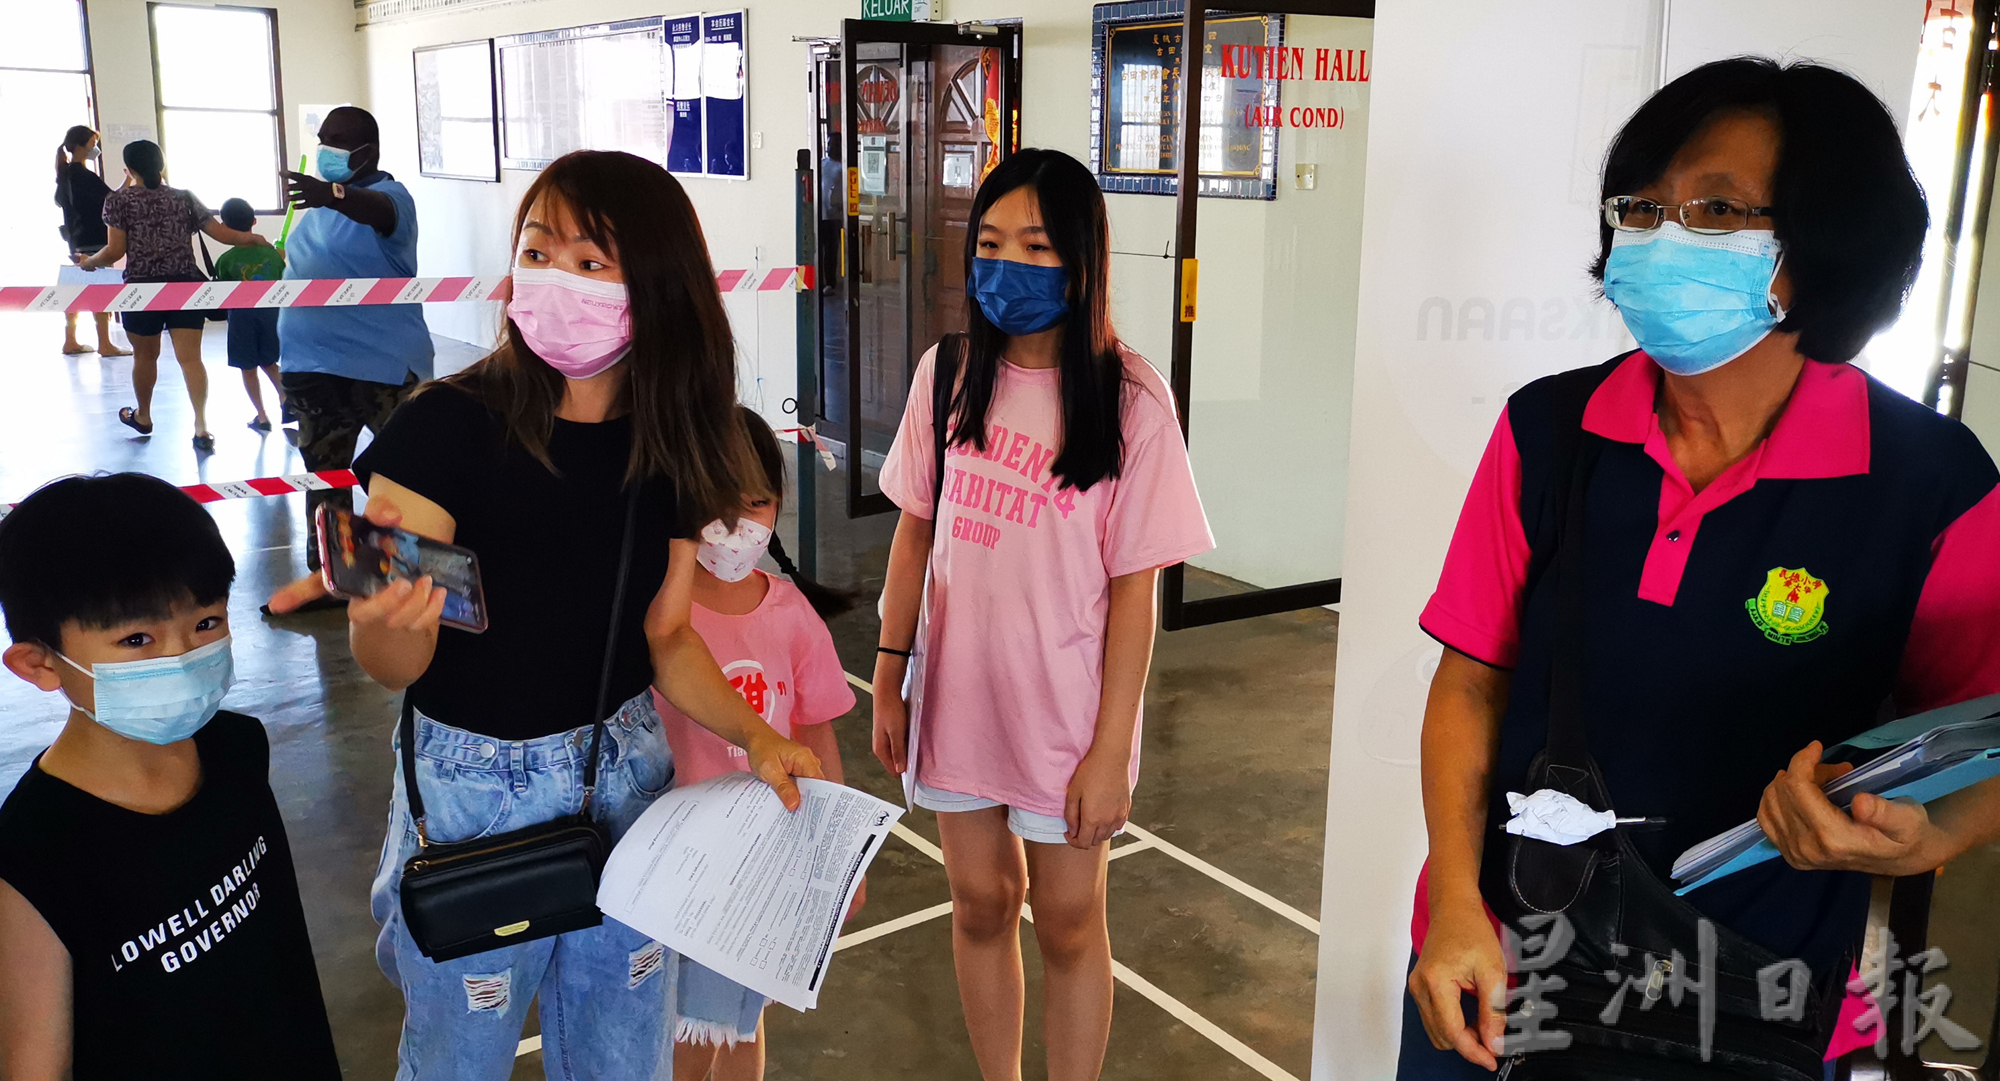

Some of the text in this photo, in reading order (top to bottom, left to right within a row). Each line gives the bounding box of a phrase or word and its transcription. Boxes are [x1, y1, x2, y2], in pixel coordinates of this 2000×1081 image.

[863, 0, 909, 18] KELUAR
[1221, 44, 1370, 82] KUTIEN HALL
[1245, 106, 1345, 130] (AIR COND)
[849, 170, 857, 198] PULL
[952, 516, 1001, 550] GROUP
[111, 835, 267, 972] LOWELL DARLING
[160, 882, 261, 973] GOVERNOR
